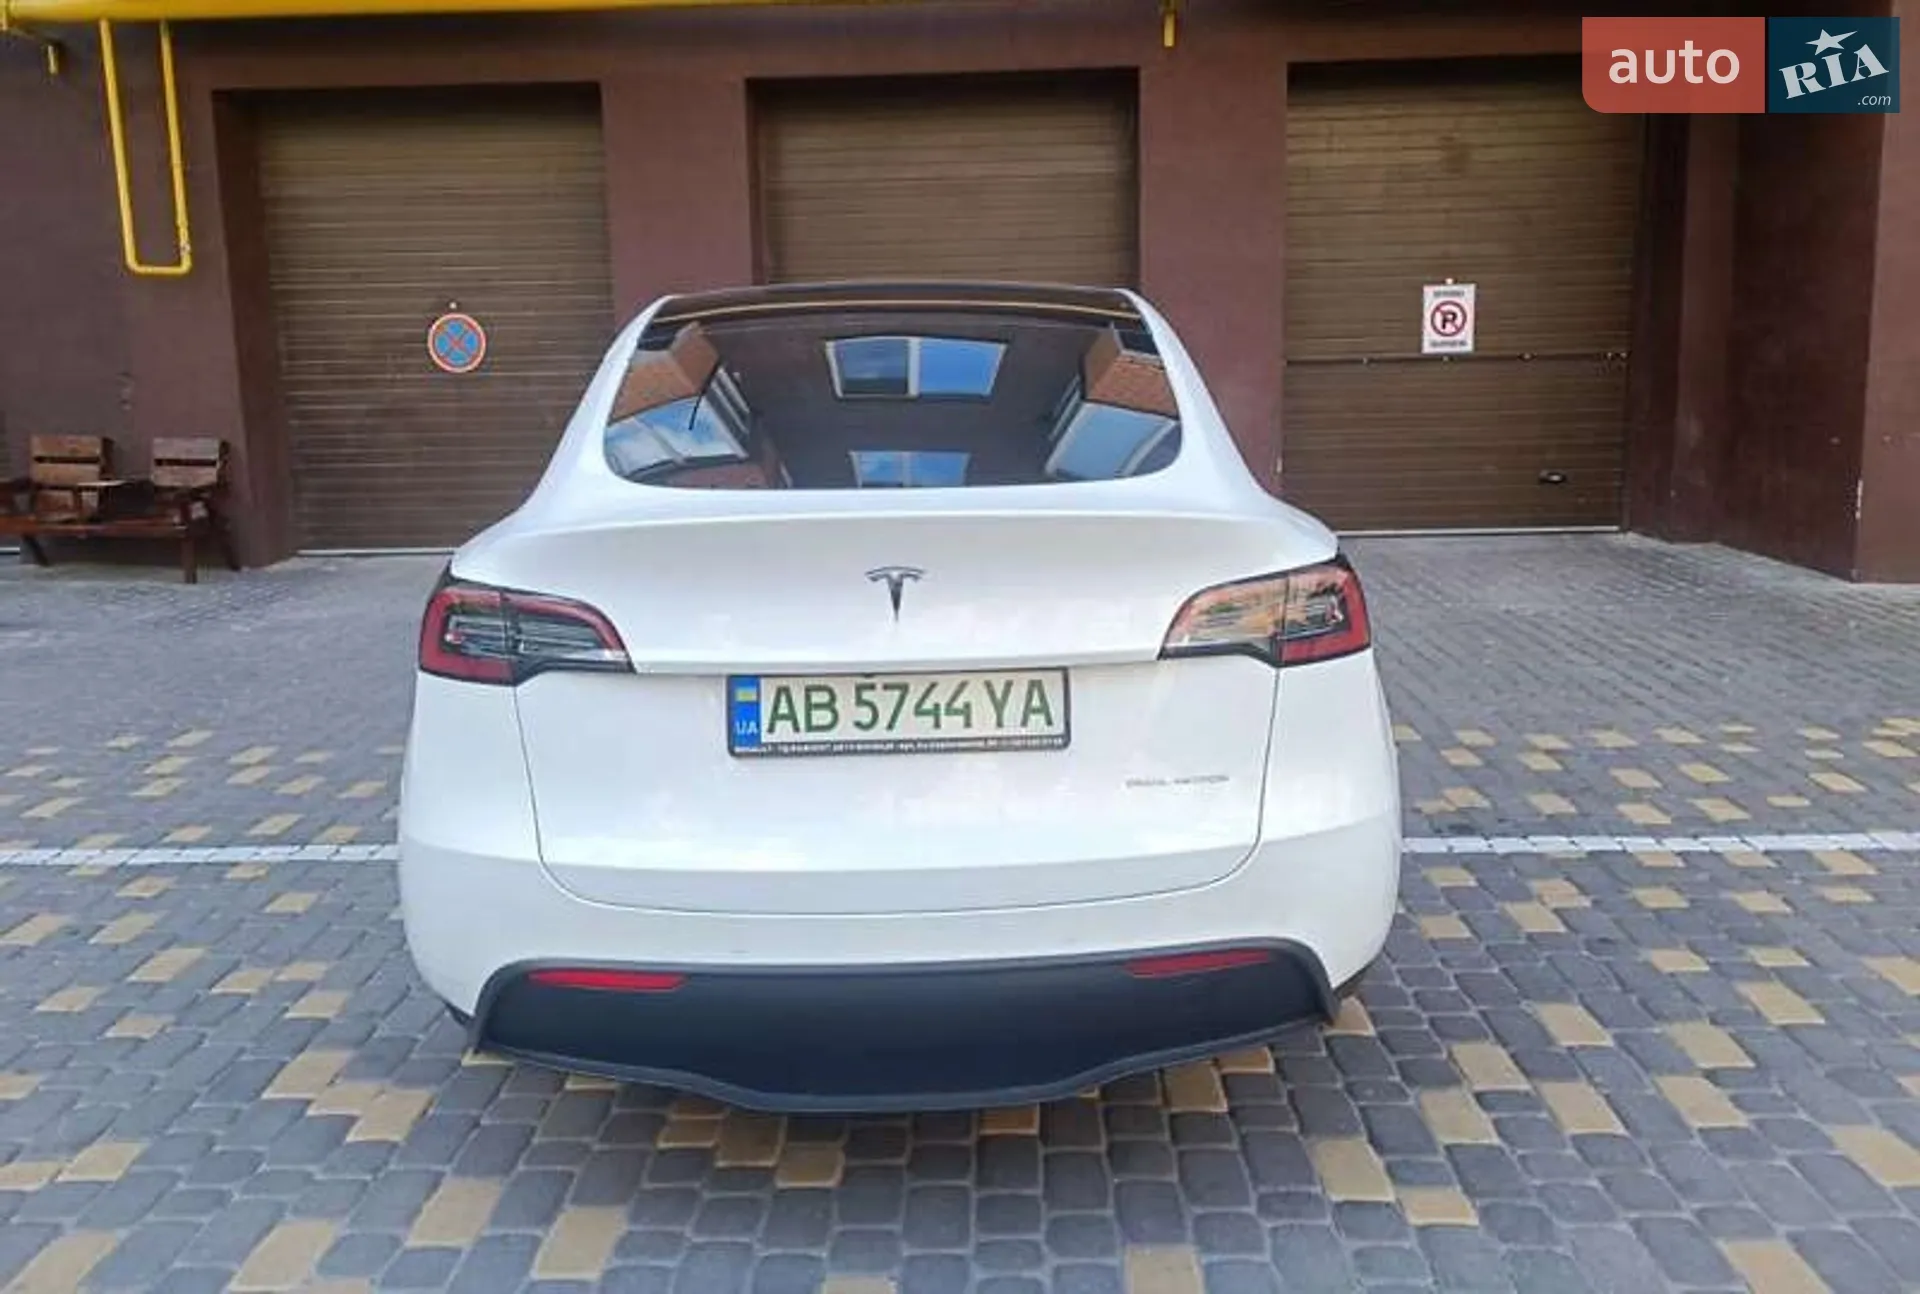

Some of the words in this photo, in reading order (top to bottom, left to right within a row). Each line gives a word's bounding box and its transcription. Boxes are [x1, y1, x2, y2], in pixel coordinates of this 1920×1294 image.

[766, 684, 840, 734] AB
[853, 681, 972, 731] 5744
[983, 679, 1054, 728] YA
[735, 721, 759, 735] UA
